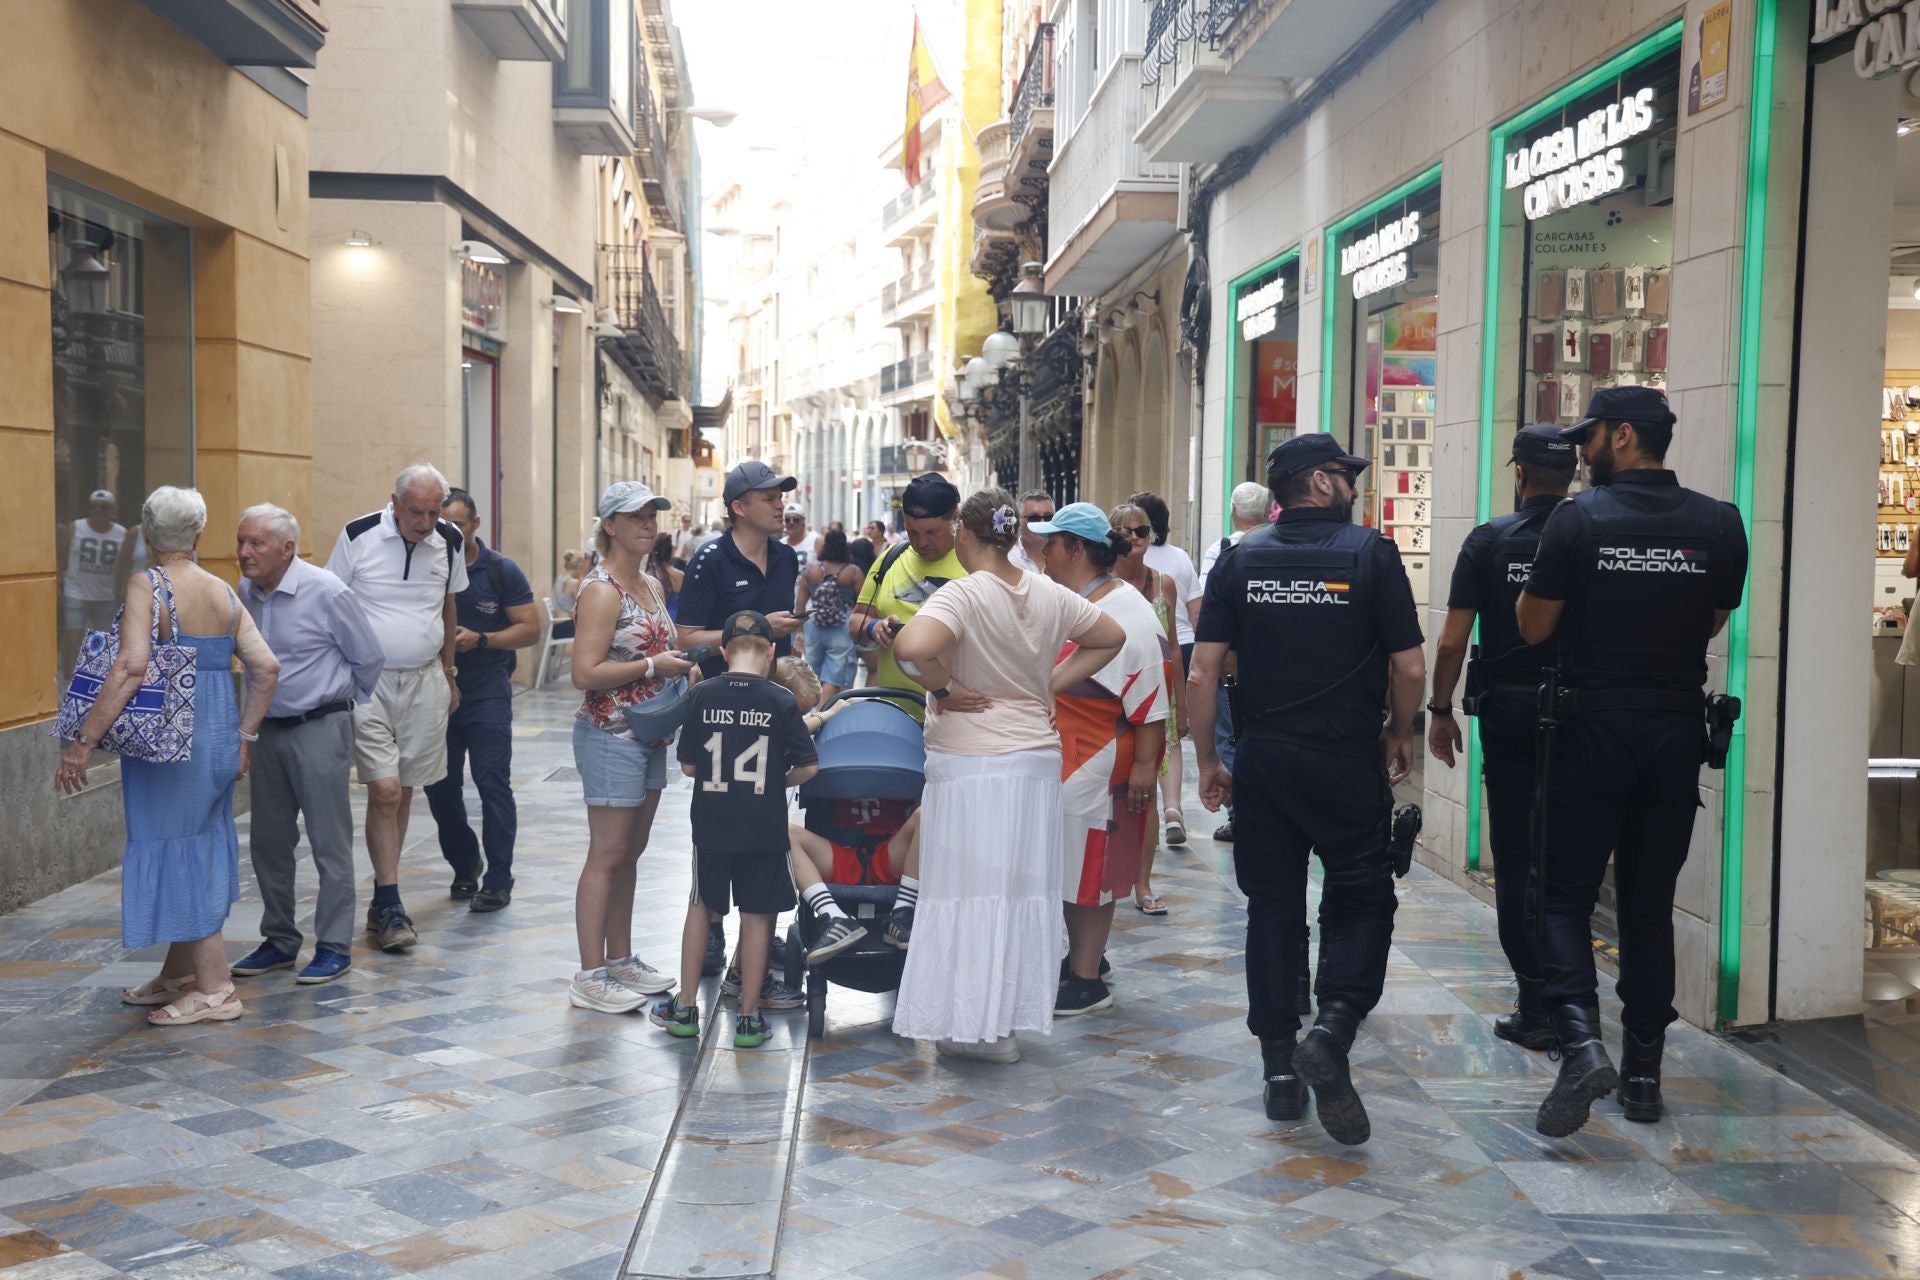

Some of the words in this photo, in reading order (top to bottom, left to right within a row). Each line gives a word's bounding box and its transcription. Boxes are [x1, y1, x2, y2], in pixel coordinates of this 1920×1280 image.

[1505, 148, 1530, 189] LA
[1530, 127, 1577, 177] CASA
[1577, 109, 1606, 160] DE
[1605, 88, 1653, 147] LAS
[1536, 232, 1594, 241] CARCASAS
[1535, 242, 1607, 254] COLGANTES
[1599, 547, 1685, 560] POLICIA
[1598, 560, 1706, 573] NACIONAL
[1247, 580, 1327, 592] POLICIA
[1247, 592, 1349, 604] NACIONAL
[703, 709, 734, 724] LUIS
[740, 708, 772, 727] DÍAZ
[703, 731, 770, 795] 14
